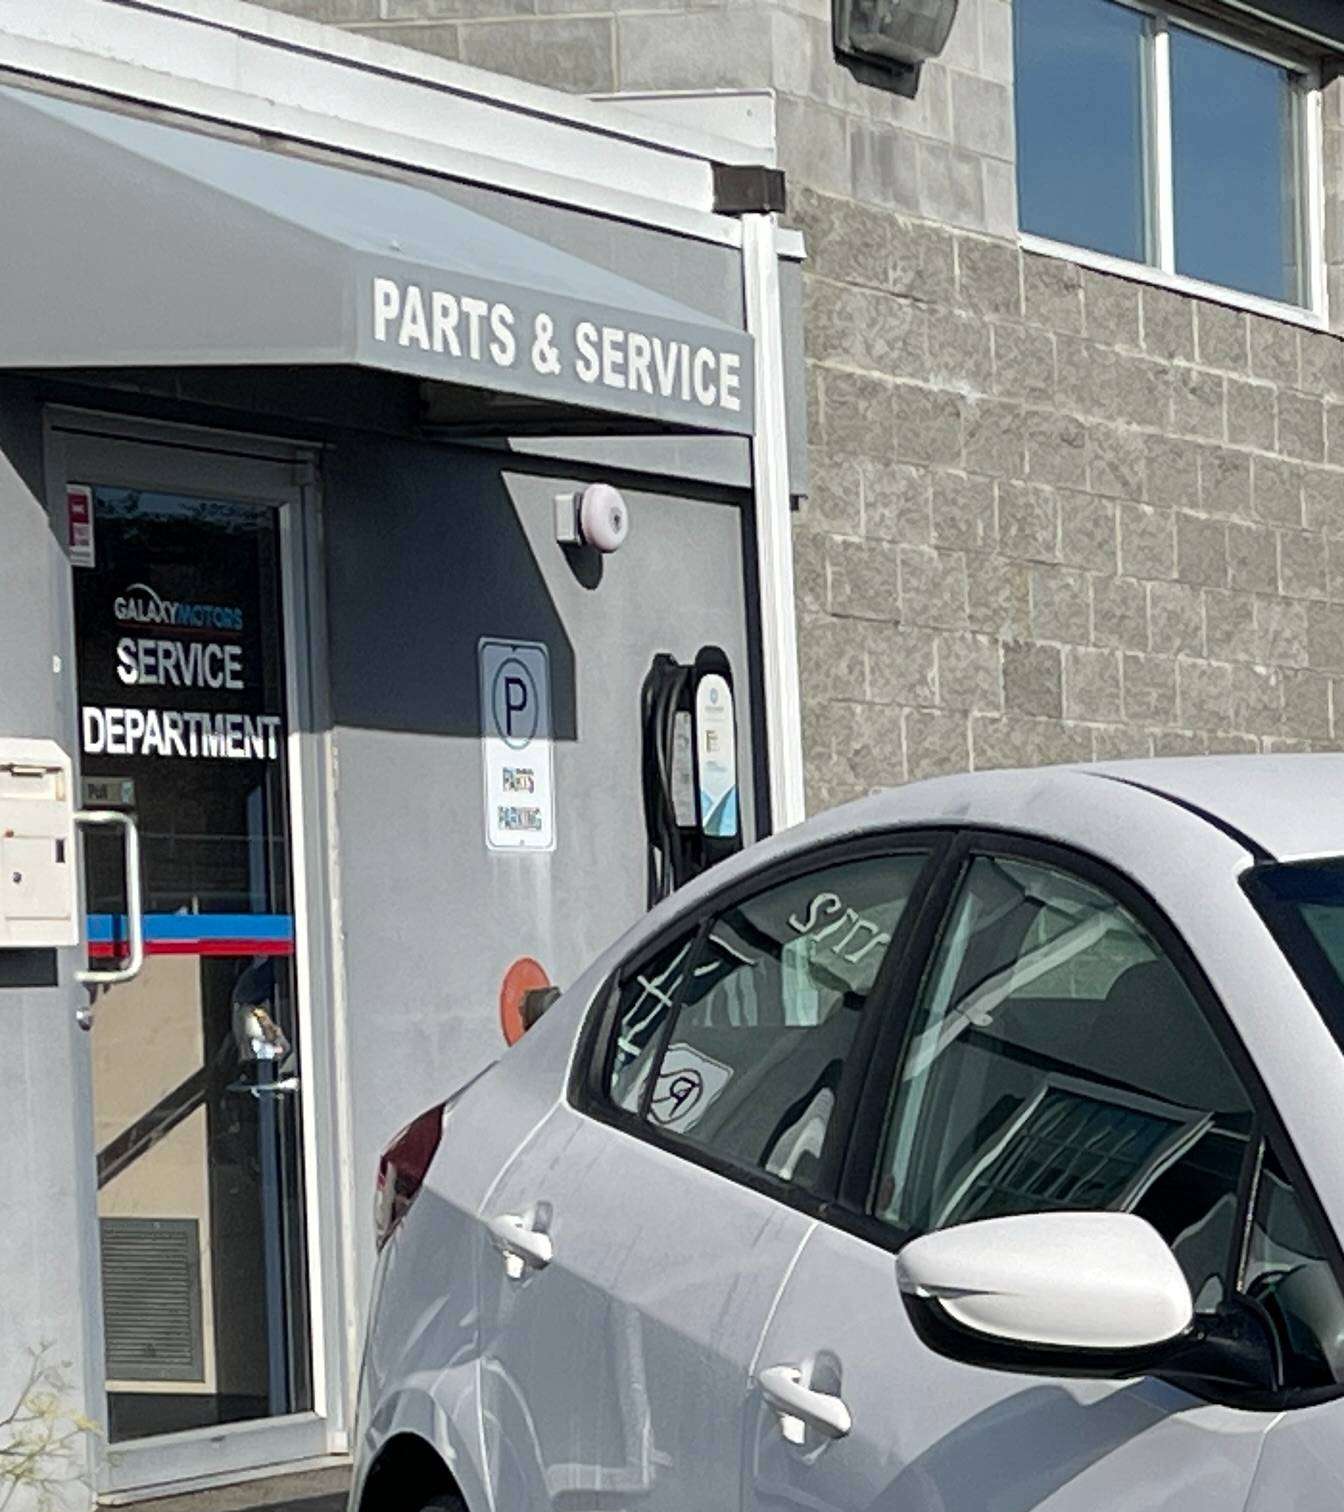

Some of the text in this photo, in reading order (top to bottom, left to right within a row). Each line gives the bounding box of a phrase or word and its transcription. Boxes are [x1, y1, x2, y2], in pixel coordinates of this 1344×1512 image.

[373, 277, 742, 412] PARTS & SERVICE
[117, 637, 244, 689] SERVICE
[82, 706, 280, 759] DEPARTMENT
[504, 676, 527, 736] P
